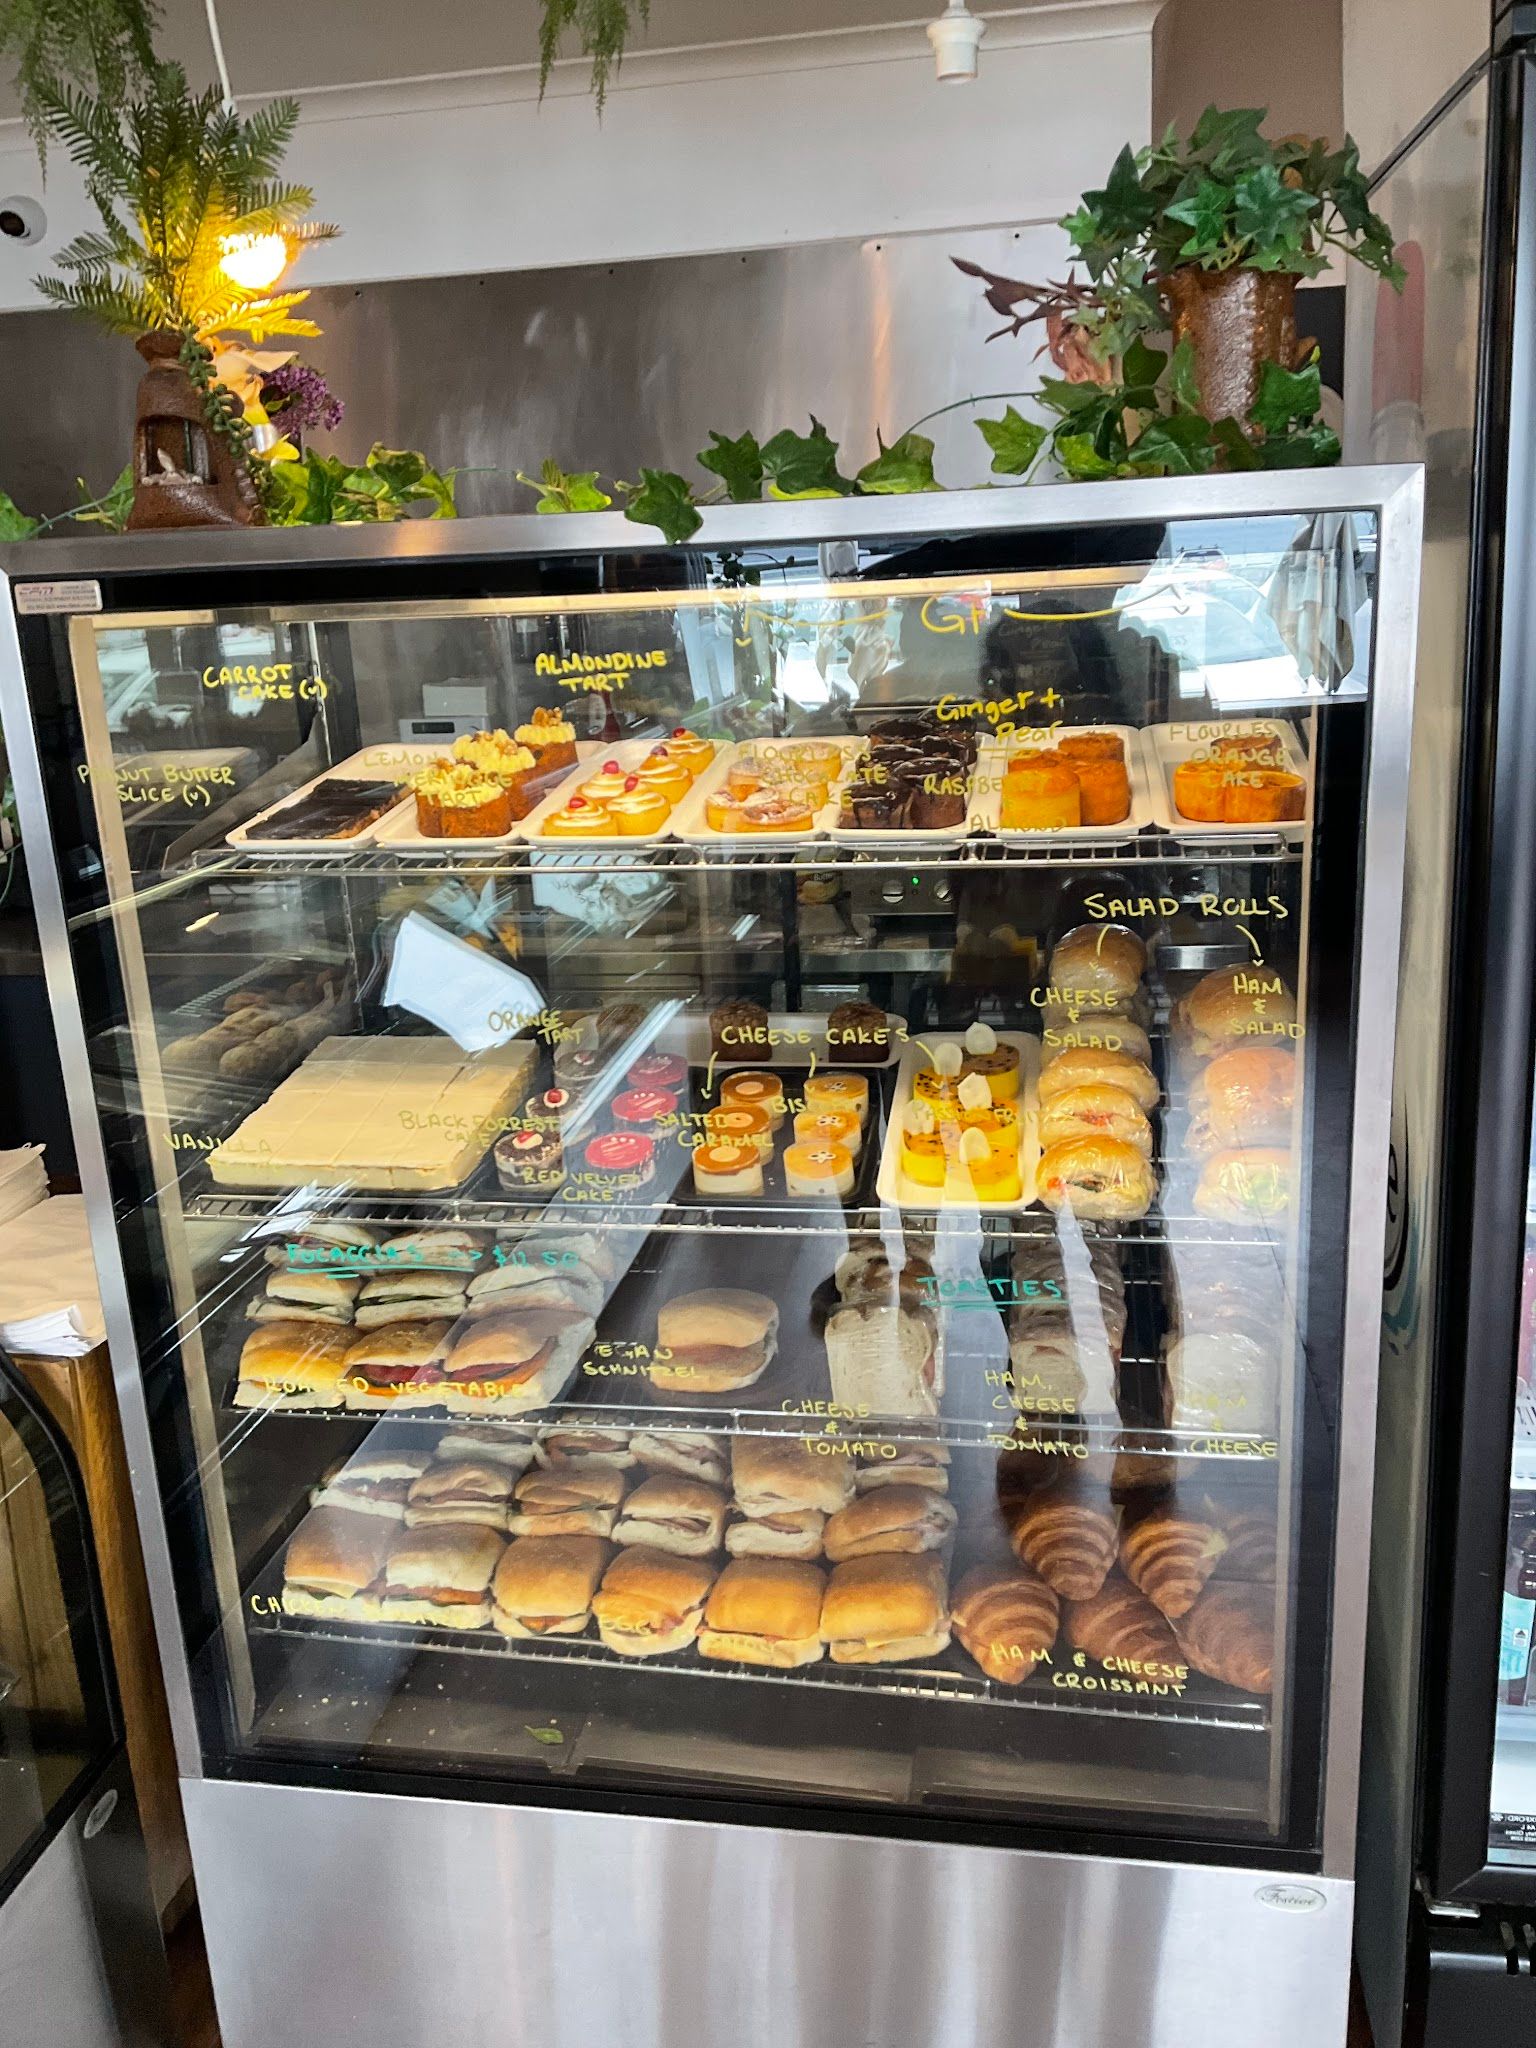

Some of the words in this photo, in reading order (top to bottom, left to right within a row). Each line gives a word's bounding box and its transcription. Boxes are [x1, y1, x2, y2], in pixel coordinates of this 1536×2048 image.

[535, 650, 667, 677] ALMONDINE
[203, 663, 293, 688] CARROT
[558, 672, 630, 692] TART
[238, 684, 294, 699] CAKE
[936, 690, 1034, 723] Ginger
[1040, 687, 1061, 709] +
[994, 720, 1063, 745] Pear
[1170, 721, 1288, 742] FLOURLES
[363, 751, 440, 768] LEMON
[738, 745, 872, 762] FLOURLSS
[1191, 747, 1289, 767] ORANGE
[77, 764, 152, 784] PNUT
[162, 763, 236, 786] BUTTER
[760, 764, 888, 786] CHOCLATE
[116, 784, 175, 803] SLICE
[424, 790, 481, 807] TART
[970, 813, 1067, 836] ALD
[1084, 893, 1179, 918] SALAD
[1200, 894, 1288, 918] ROLLS
[1233, 975, 1282, 995] HAM
[1030, 987, 1118, 1007] CHEESE
[488, 1009, 562, 1032] ORANGE
[1230, 1018, 1306, 1038] SALAD
[537, 1022, 584, 1045] TART
[721, 1025, 811, 1045] CHEESE
[1043, 1028, 1122, 1050] SALAD
[399, 1110, 467, 1130] BLACK
[655, 1110, 729, 1128] SALTED
[677, 1130, 774, 1147] CARAMEL
[522, 1167, 563, 1184] RED
[562, 1186, 614, 1202] CAKE
[916, 1276, 1062, 1298] TOASTIES
[592, 1343, 673, 1359] EGAN
[583, 1361, 710, 1378] SCHNITZEL
[263, 1376, 369, 1394] ROAED
[781, 1399, 871, 1418] CHEESE
[992, 1395, 1076, 1413] CHEESE
[800, 1438, 897, 1459] TOMATO
[986, 1434, 1089, 1459] TOMATO
[1190, 1439, 1278, 1458] CHEESE
[990, 1641, 1053, 1665] HAM
[1103, 1656, 1189, 1679] CHEESE
[1052, 1672, 1187, 1697] CROISSANT
